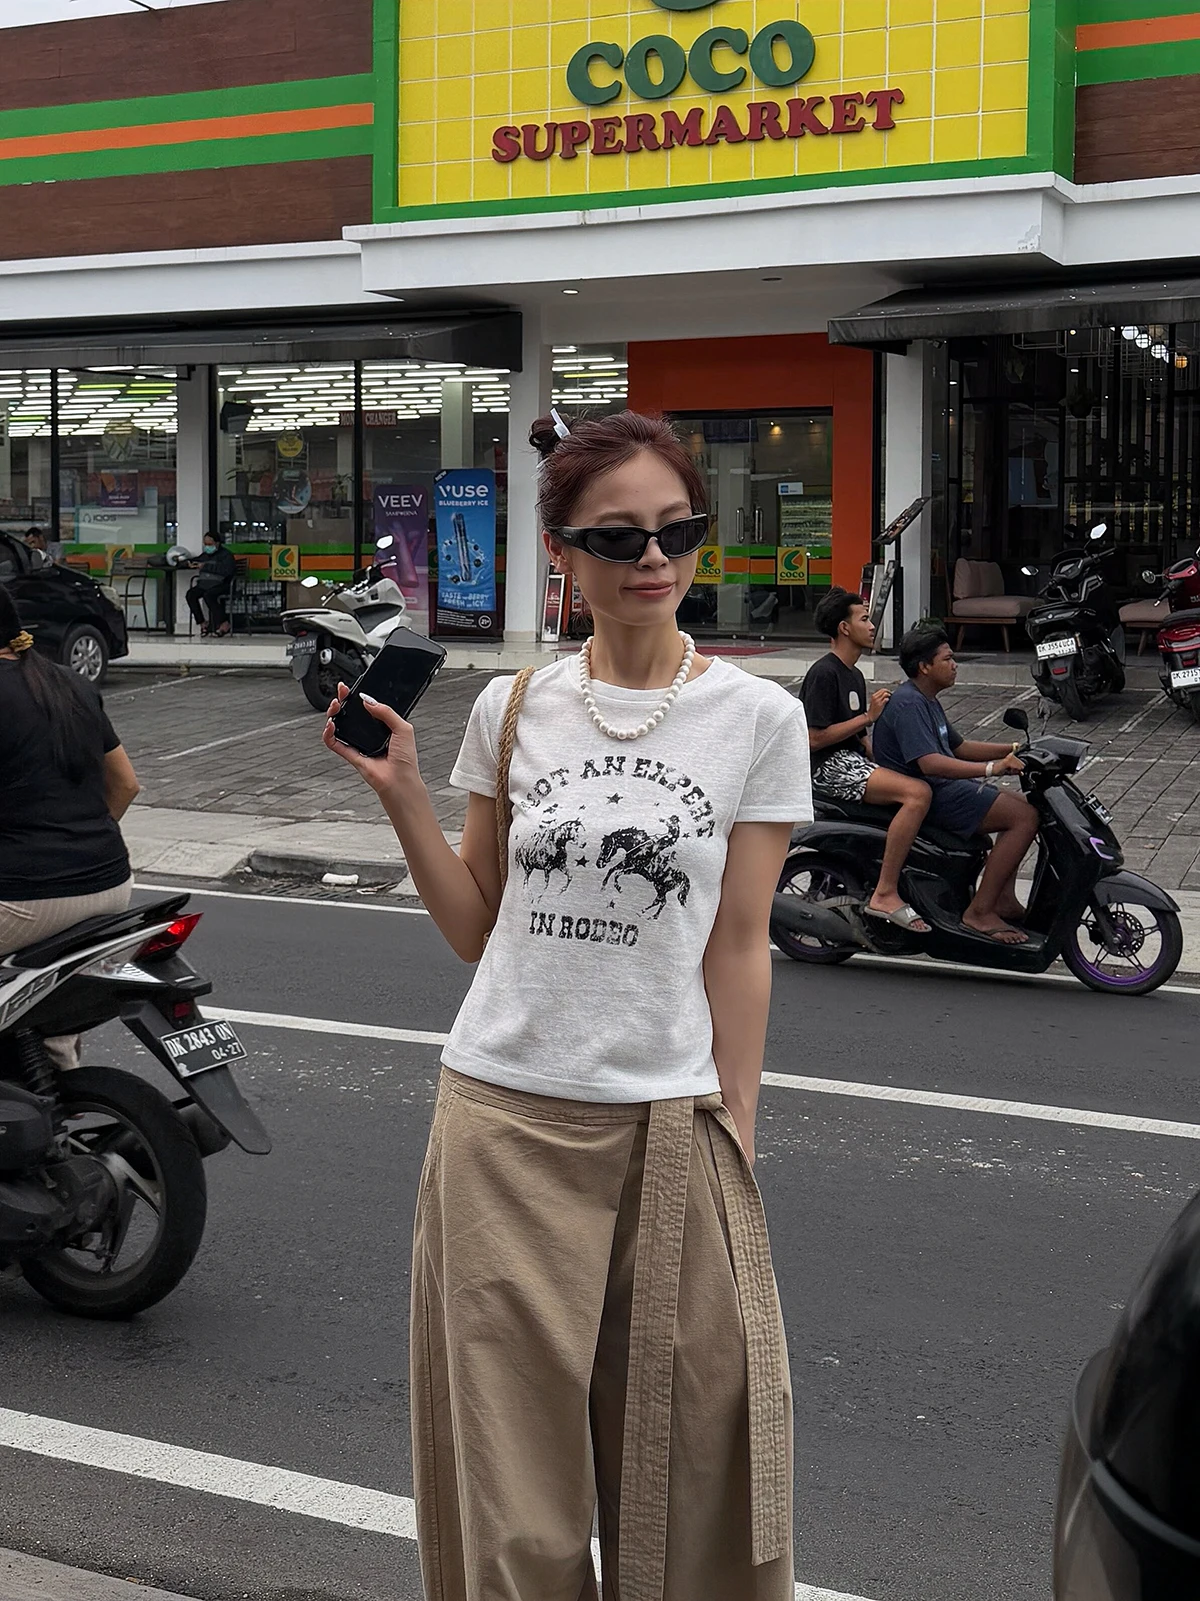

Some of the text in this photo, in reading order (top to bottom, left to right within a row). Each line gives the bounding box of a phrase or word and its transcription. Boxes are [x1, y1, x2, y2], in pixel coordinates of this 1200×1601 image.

[566, 19, 815, 105] COCO
[491, 88, 905, 164] SUPERMARKET
[378, 494, 423, 507] VEEV
[579, 755, 627, 780] AN
[631, 757, 716, 839] EXPERT
[529, 910, 640, 947] IN RODEO
[165, 1036, 189, 1058] DK
[183, 1027, 217, 1051] 2843
